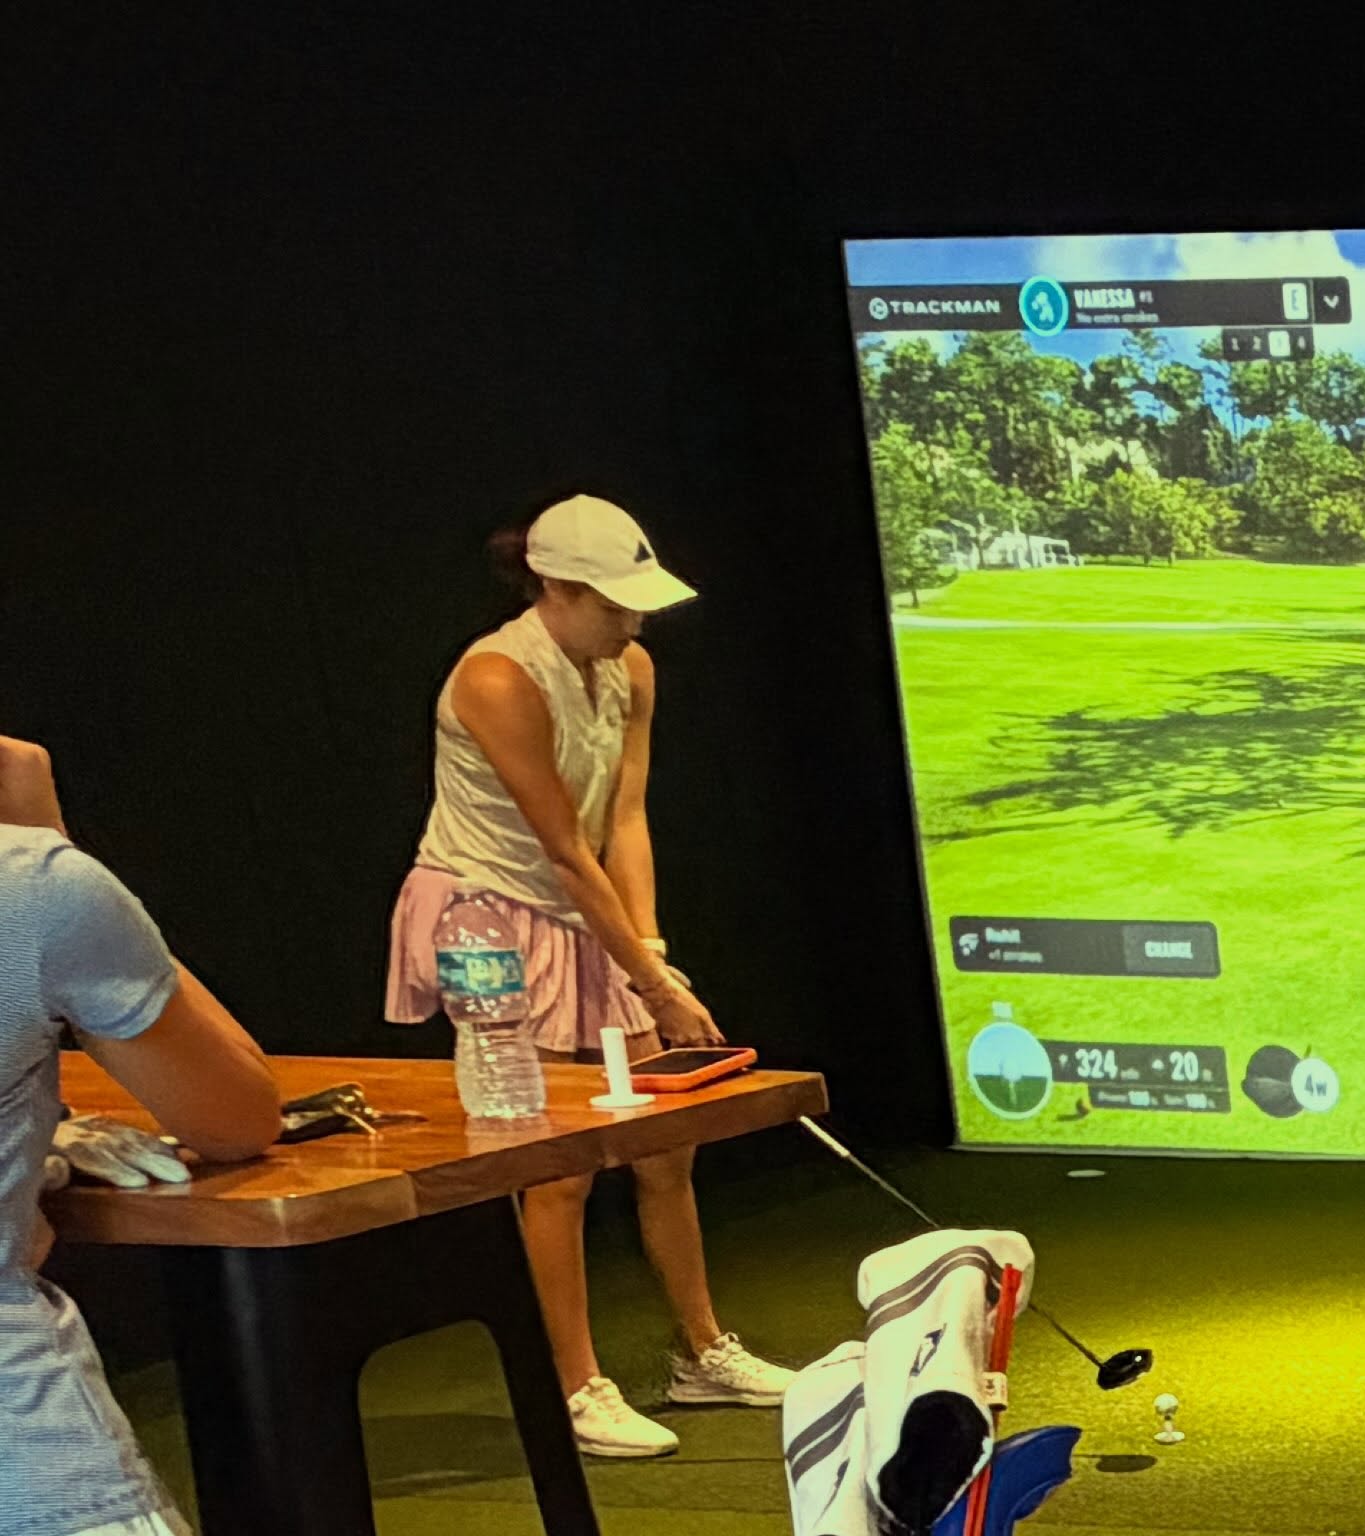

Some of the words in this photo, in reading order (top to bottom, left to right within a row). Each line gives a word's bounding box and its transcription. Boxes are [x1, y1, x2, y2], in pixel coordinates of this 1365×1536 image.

[889, 299, 1001, 315] TRACKMAN
[1074, 288, 1136, 309] VANESSA
[1075, 1048, 1118, 1080] 324
[1169, 1051, 1199, 1082] 20
